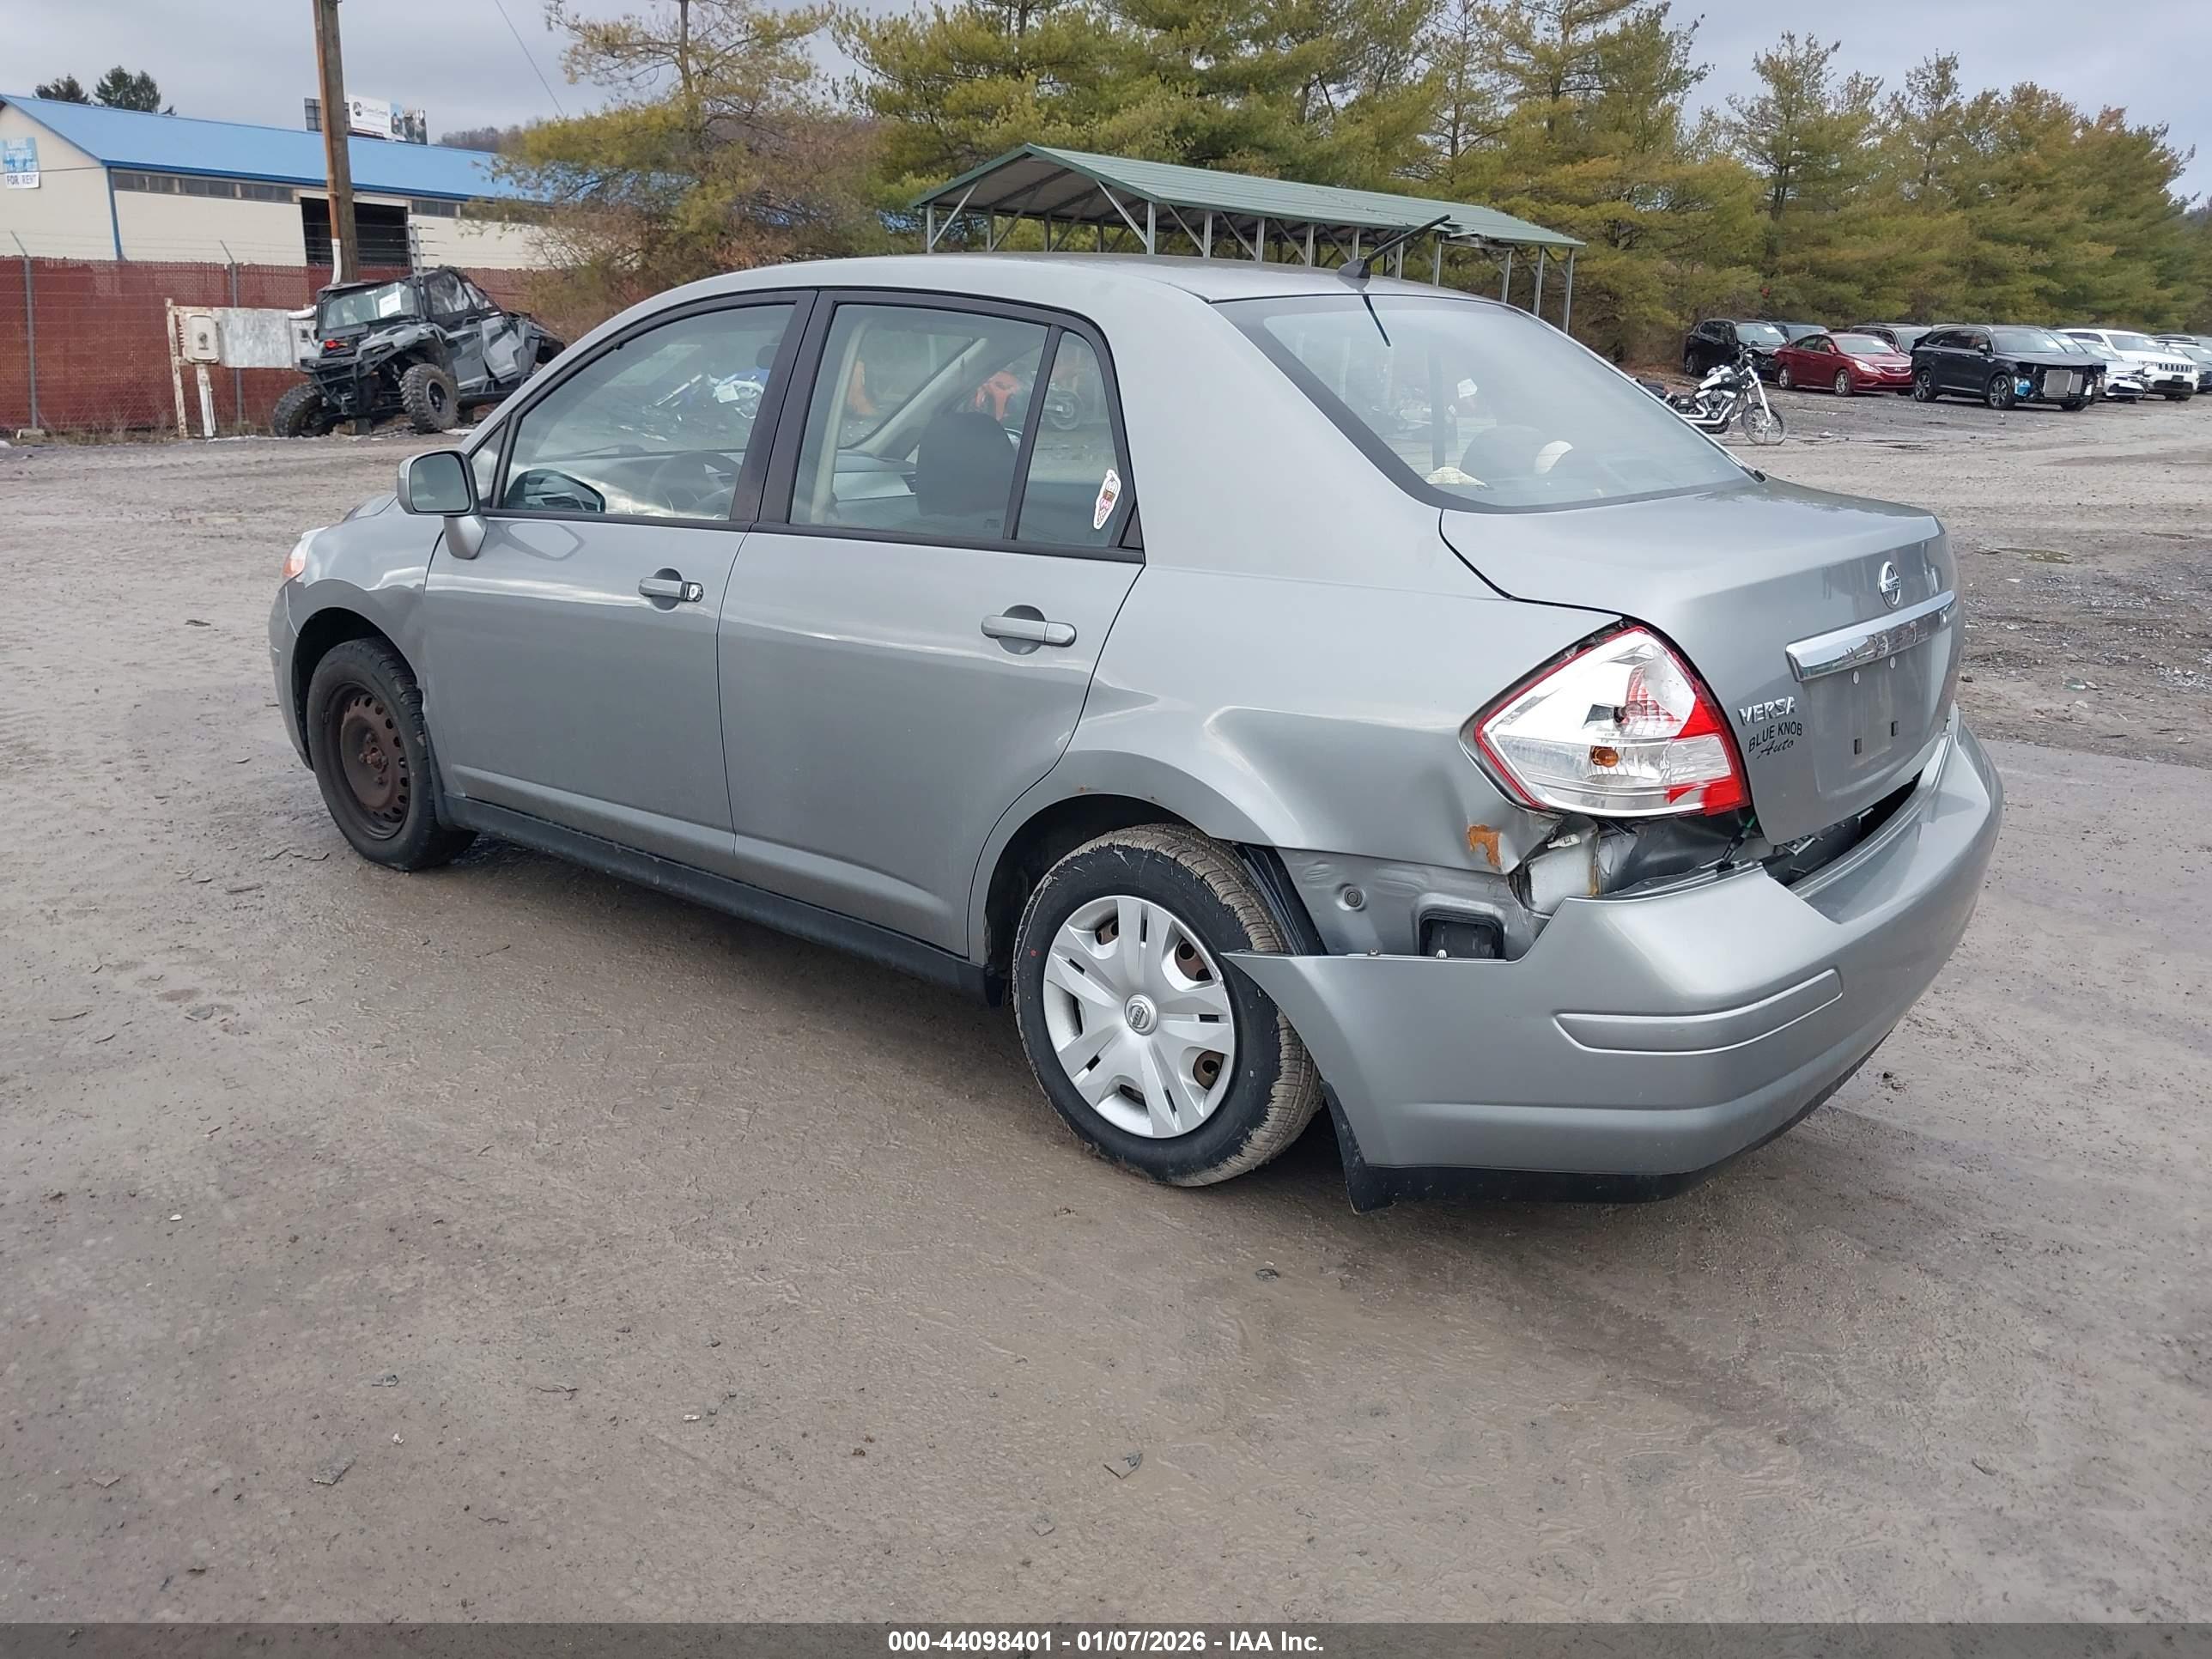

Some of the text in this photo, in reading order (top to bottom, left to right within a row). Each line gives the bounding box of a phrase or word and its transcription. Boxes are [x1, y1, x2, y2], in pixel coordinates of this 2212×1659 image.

[7, 174, 19, 185] FOR
[1738, 696, 1795, 726] VERSA
[1748, 721, 1802, 753] BLUE KNOB
[1756, 738, 1793, 759] Auto
